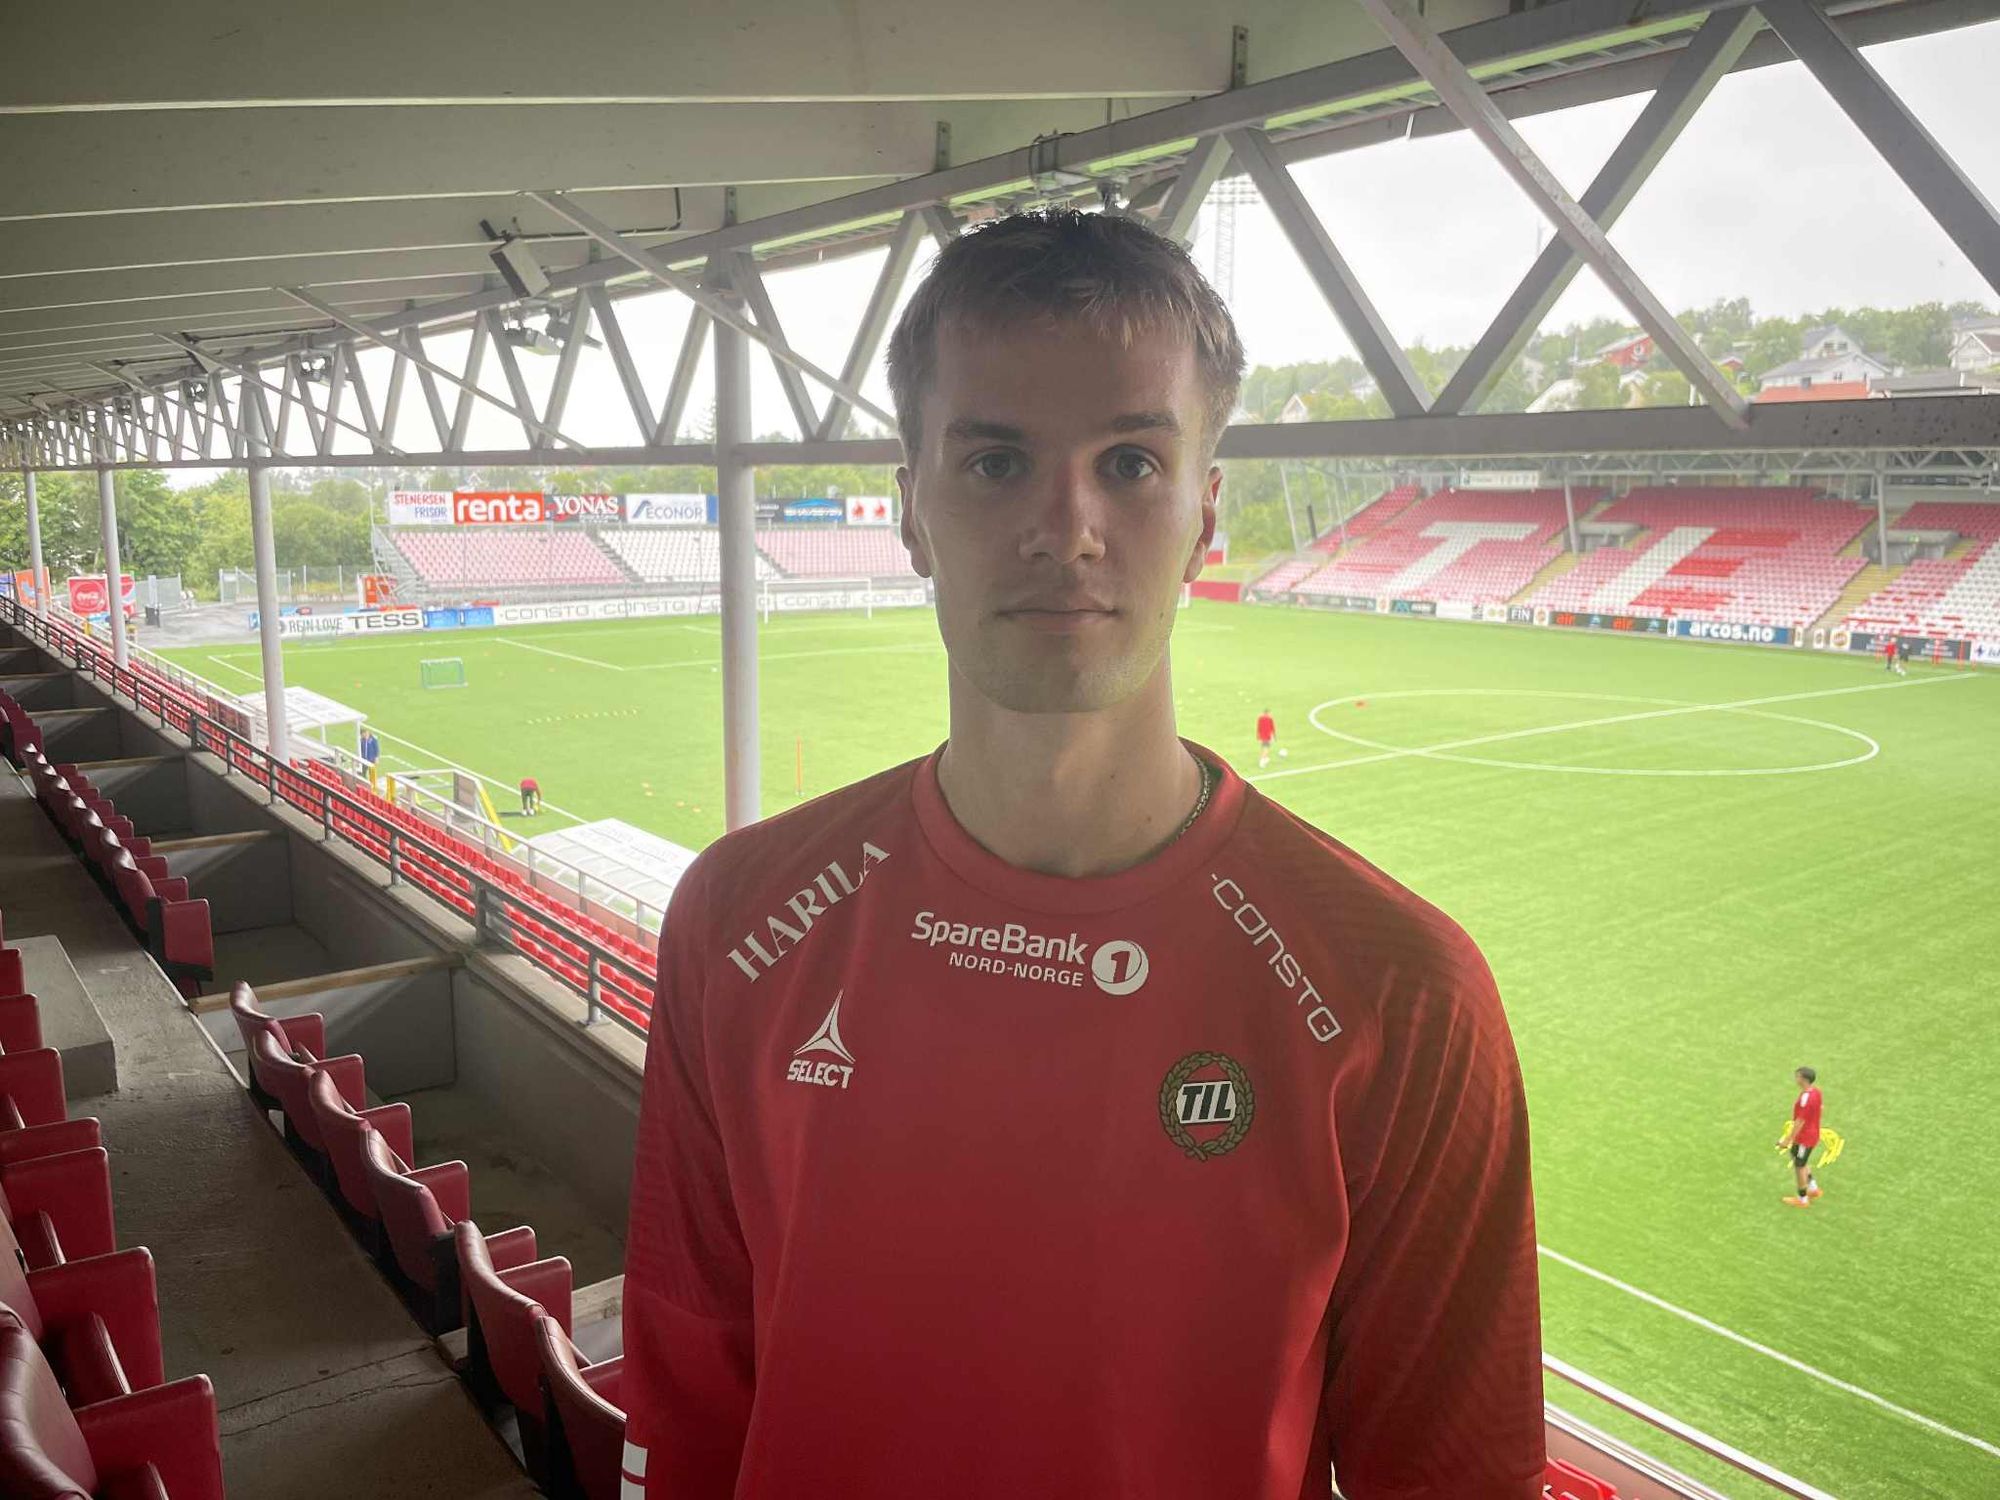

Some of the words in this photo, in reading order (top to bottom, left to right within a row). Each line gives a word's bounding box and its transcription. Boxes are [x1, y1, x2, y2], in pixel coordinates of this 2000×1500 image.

[393, 493, 446, 506] STENERSEN
[456, 494, 541, 523] renta
[552, 495, 620, 515] YONAS
[645, 505, 703, 521] ECONOR
[349, 611, 420, 630] TESS
[1690, 621, 1775, 643] arcos.no
[727, 841, 891, 984] HARILA
[911, 911, 1090, 965] SpareBank
[949, 951, 1085, 988] NORD-NORGE
[786, 1058, 854, 1089] SELECT
[1180, 1083, 1233, 1121] TIL
